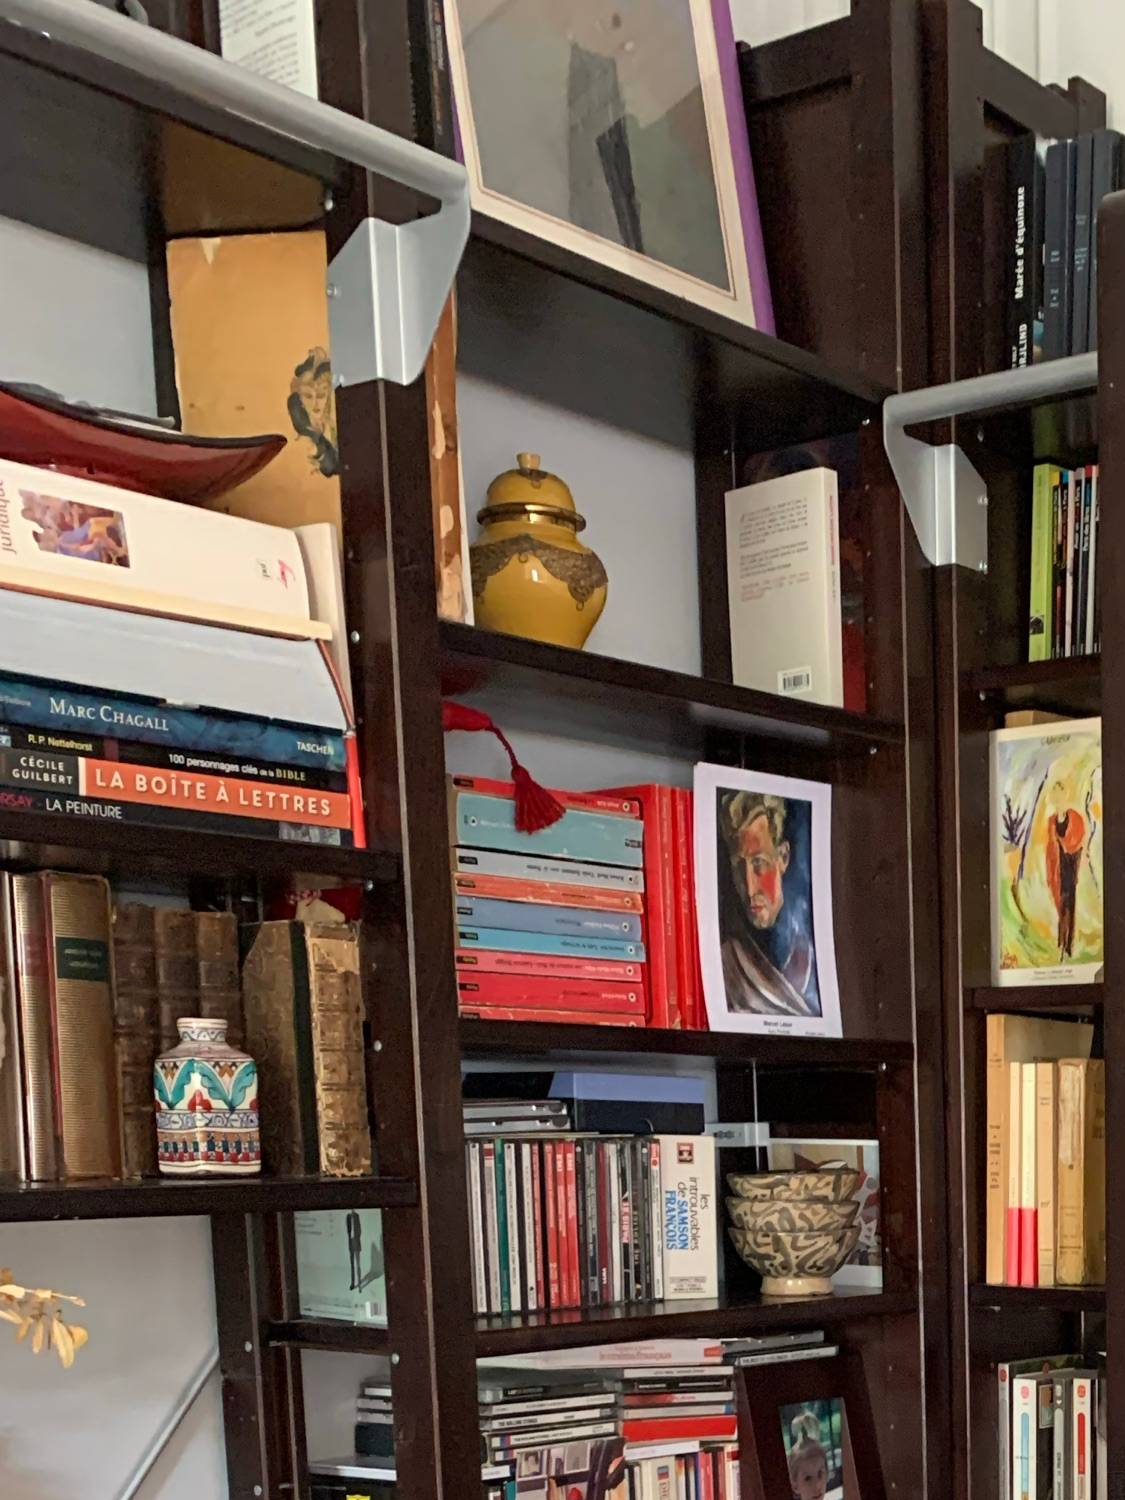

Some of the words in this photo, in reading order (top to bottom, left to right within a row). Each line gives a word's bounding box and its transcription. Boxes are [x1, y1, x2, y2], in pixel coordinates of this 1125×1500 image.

[1015, 186, 1026, 256] d'équinoxe
[1014, 259, 1024, 298] Marée
[1018, 323, 1027, 367] RJLIND
[50, 698, 95, 719] MARC
[100, 706, 169, 731] CHAGALL
[20, 756, 64, 771] CÉCILE
[296, 741, 335, 755] TASCHEN
[12, 769, 73, 785] GUILBERT
[168, 754, 185, 764] 100
[186, 757, 240, 773] personnages
[241, 764, 258, 775] clés
[276, 769, 306, 781] BIBLE
[95, 768, 124, 789] LA
[135, 772, 206, 800] BOÎTE
[216, 780, 229, 803] À
[240, 788, 331, 815] LETTRES
[46, 798, 63, 812] LA
[66, 801, 123, 819] PEINTURE
[677, 1181, 687, 1197] de
[700, 1193, 711, 1210] les
[665, 1190, 677, 1250] FRANÇOIS
[677, 1199, 688, 1250] SAMSON
[689, 1176, 699, 1251] introuvables
